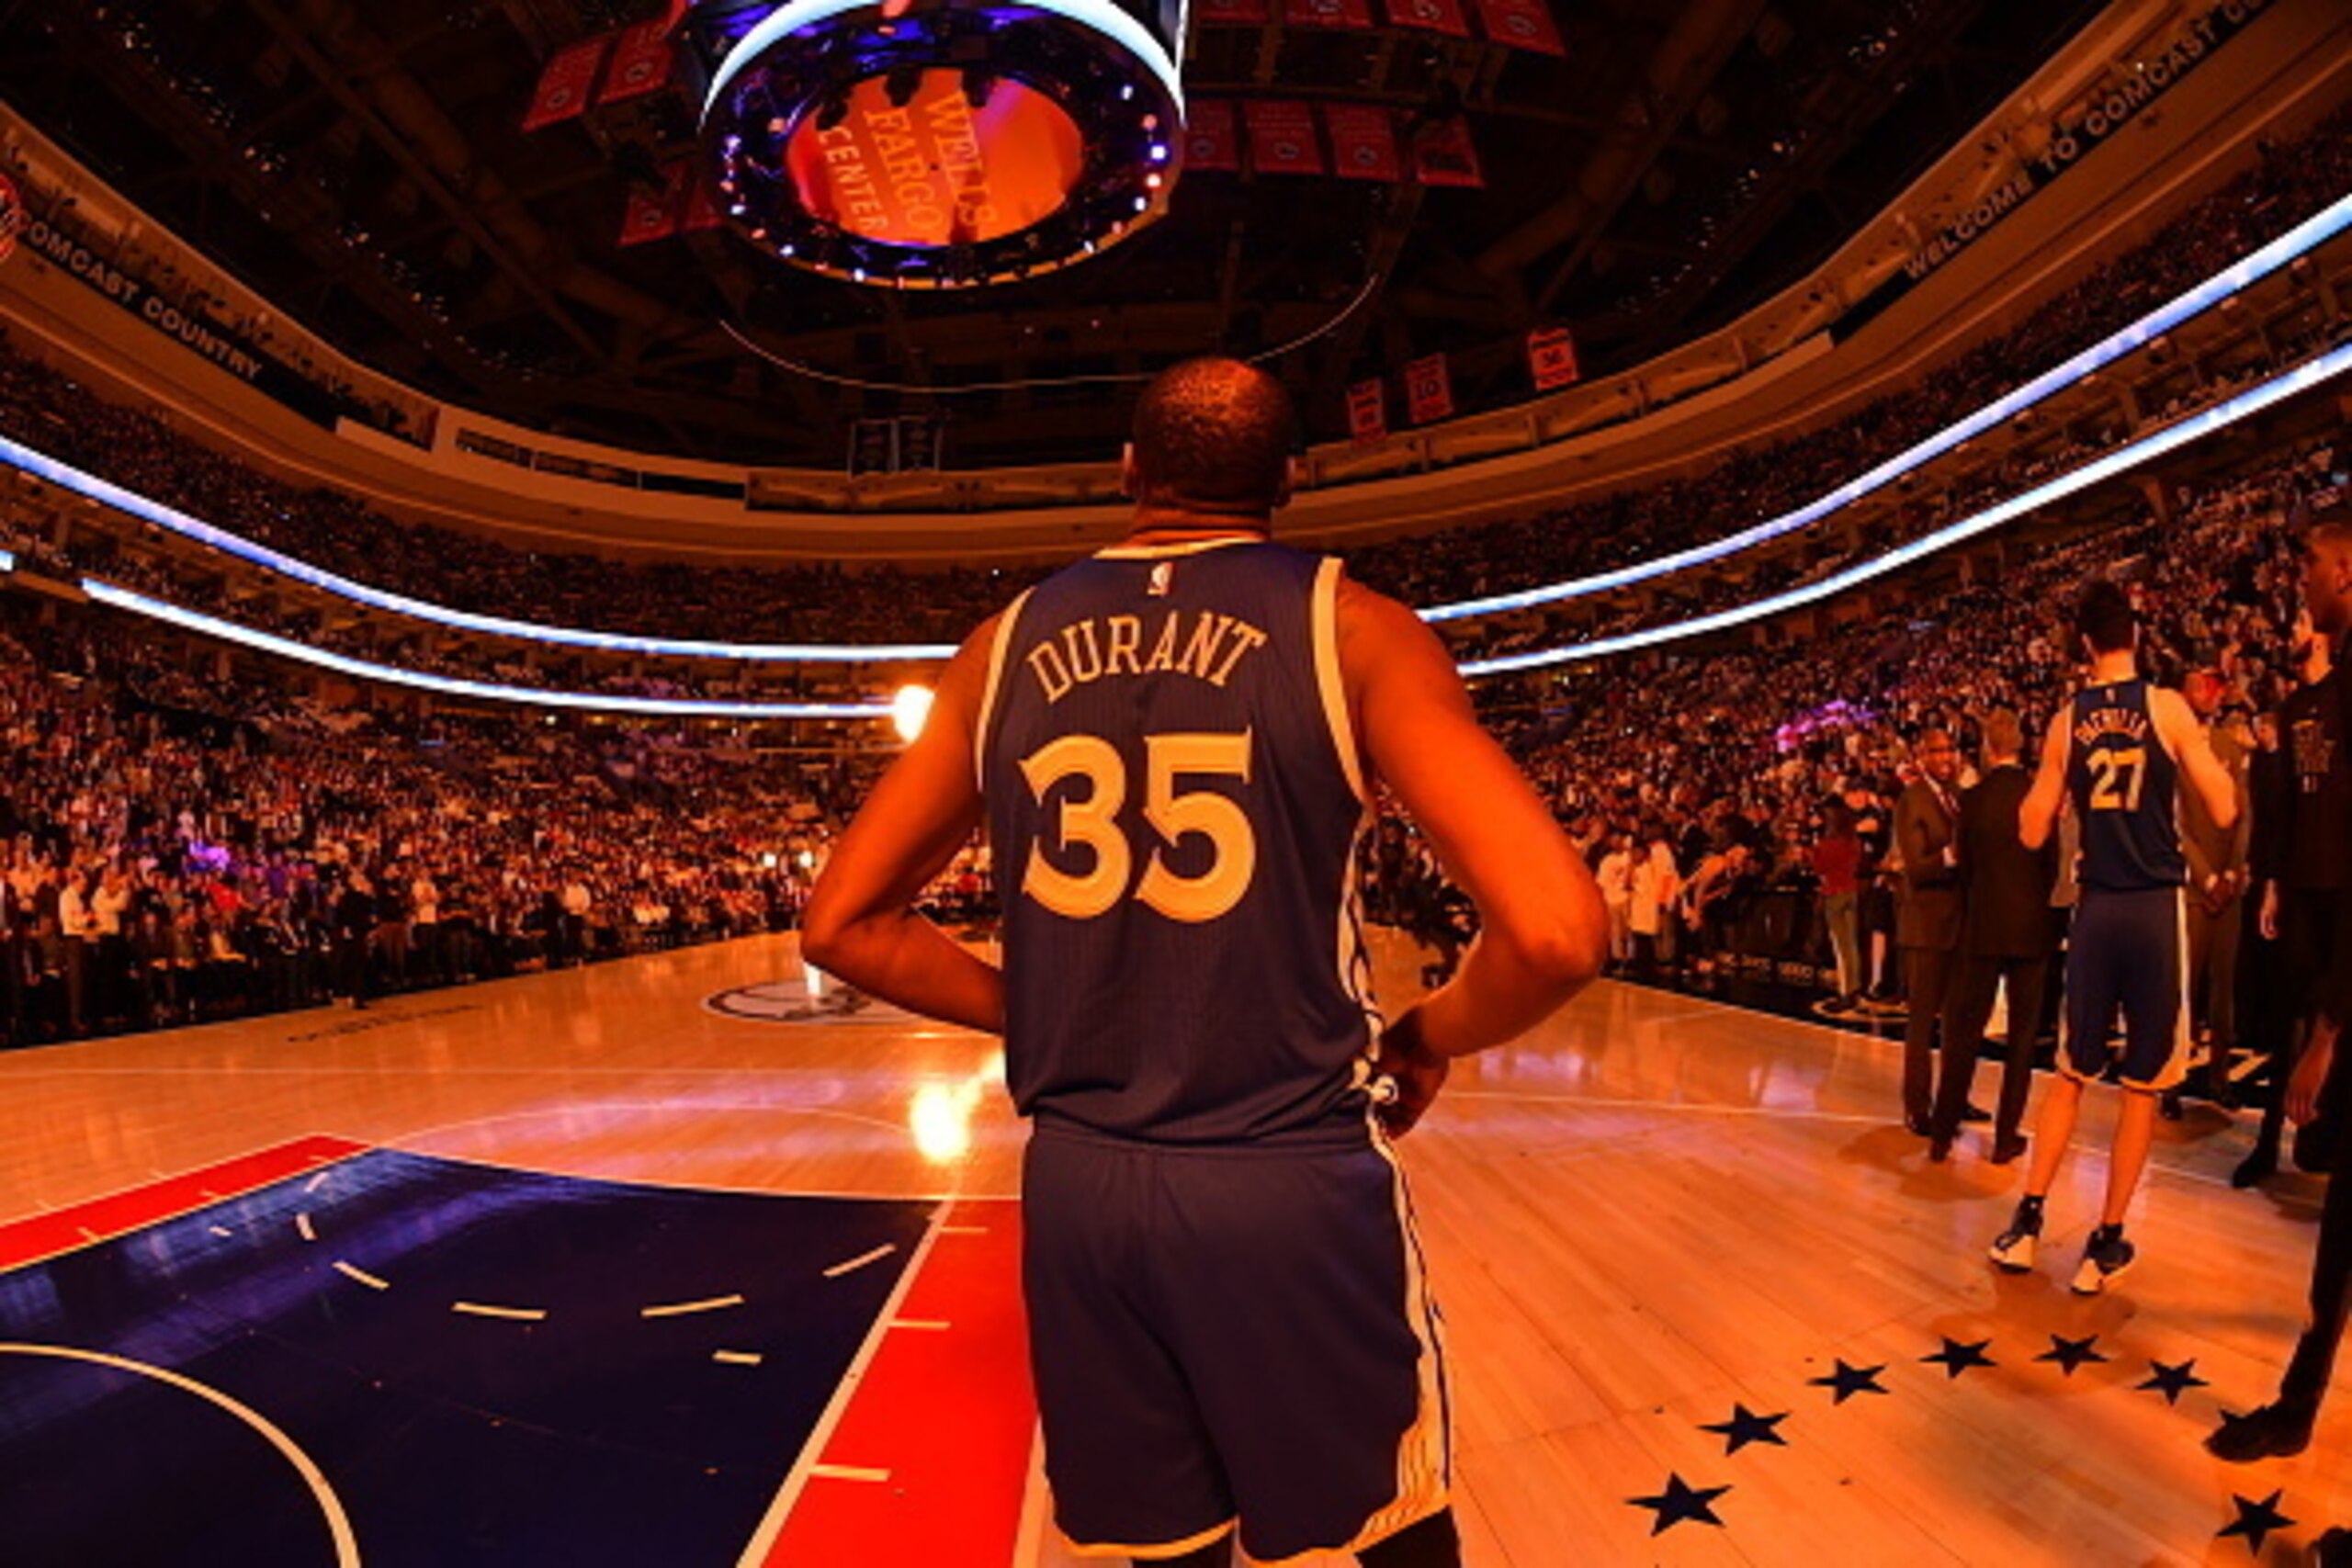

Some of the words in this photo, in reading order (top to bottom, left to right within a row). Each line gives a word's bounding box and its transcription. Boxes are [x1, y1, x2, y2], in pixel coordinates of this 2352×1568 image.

[820, 125, 888, 231] CENTER
[863, 107, 944, 231] FARGO
[1904, 169, 2035, 280] WELCOME
[2037, 136, 2080, 175] TO
[2085, 15, 2218, 137] COMCAST
[142, 294, 264, 380] COUNTRY
[1025, 610, 1269, 705] DURANT
[1016, 724, 1257, 924] 35
[2085, 747, 2146, 812] 27
